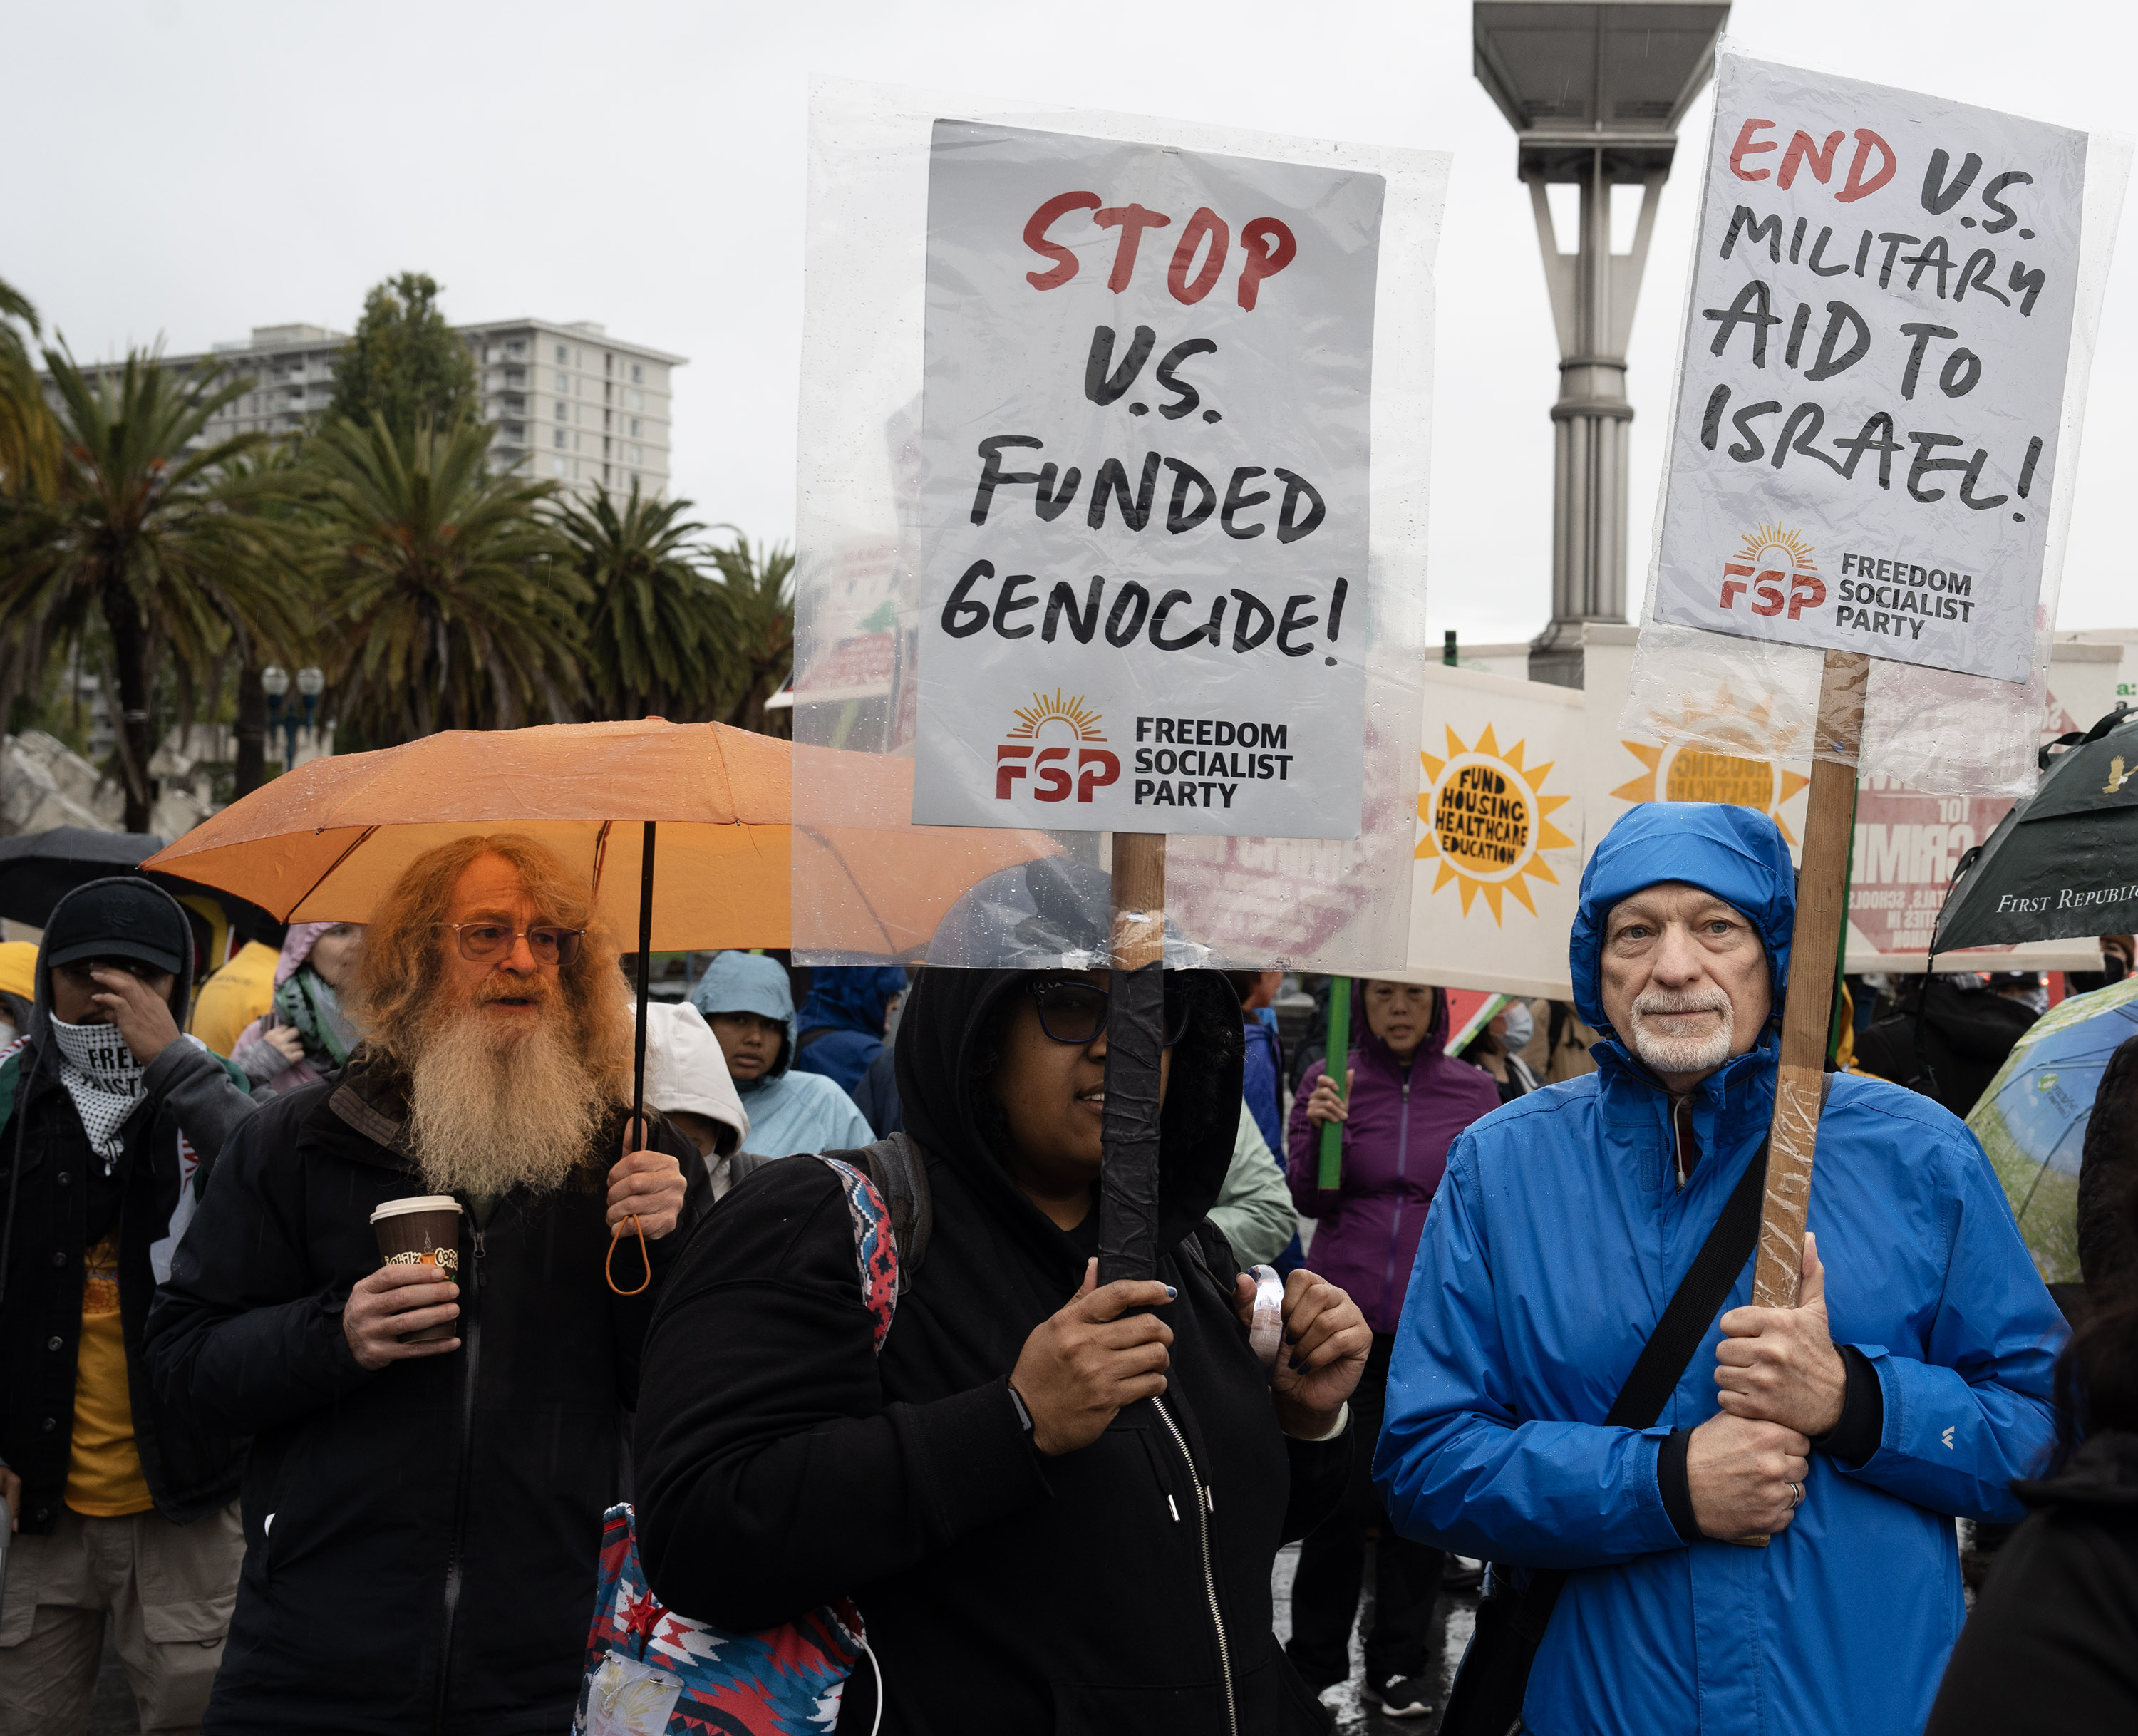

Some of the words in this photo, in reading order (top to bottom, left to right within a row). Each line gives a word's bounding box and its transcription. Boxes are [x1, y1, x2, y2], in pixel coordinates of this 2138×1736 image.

[1730, 118, 1896, 203] END
[1921, 148, 2035, 240] U.S.
[1023, 191, 1296, 312] STOP
[1719, 205, 2045, 317] MILITARY
[1702, 279, 1871, 382] AID
[1899, 323, 1982, 401] TO
[1084, 325, 1222, 425] U.S.
[1700, 383, 2043, 522] ISRAEL!
[970, 435, 1326, 544] FUNDED
[1719, 562, 1827, 621] FSP
[1842, 552, 1972, 596] FREEDOM
[941, 559, 1348, 667] GENOCIDE!
[1836, 604, 1926, 640] PARTY
[1838, 579, 1976, 623] SOCIALIST
[1136, 716, 1288, 750] FREEDOM
[996, 745, 1121, 803] FSP
[1135, 748, 1293, 781] SOCIALIST
[1460, 768, 1505, 795] FUND
[1135, 779, 1239, 809] PARTY
[1442, 787, 1524, 822] HOUSING
[1435, 810, 1528, 847] HEALTHCARE
[1442, 835, 1515, 865] EDUCATION
[1995, 894, 2052, 913] FIRST
